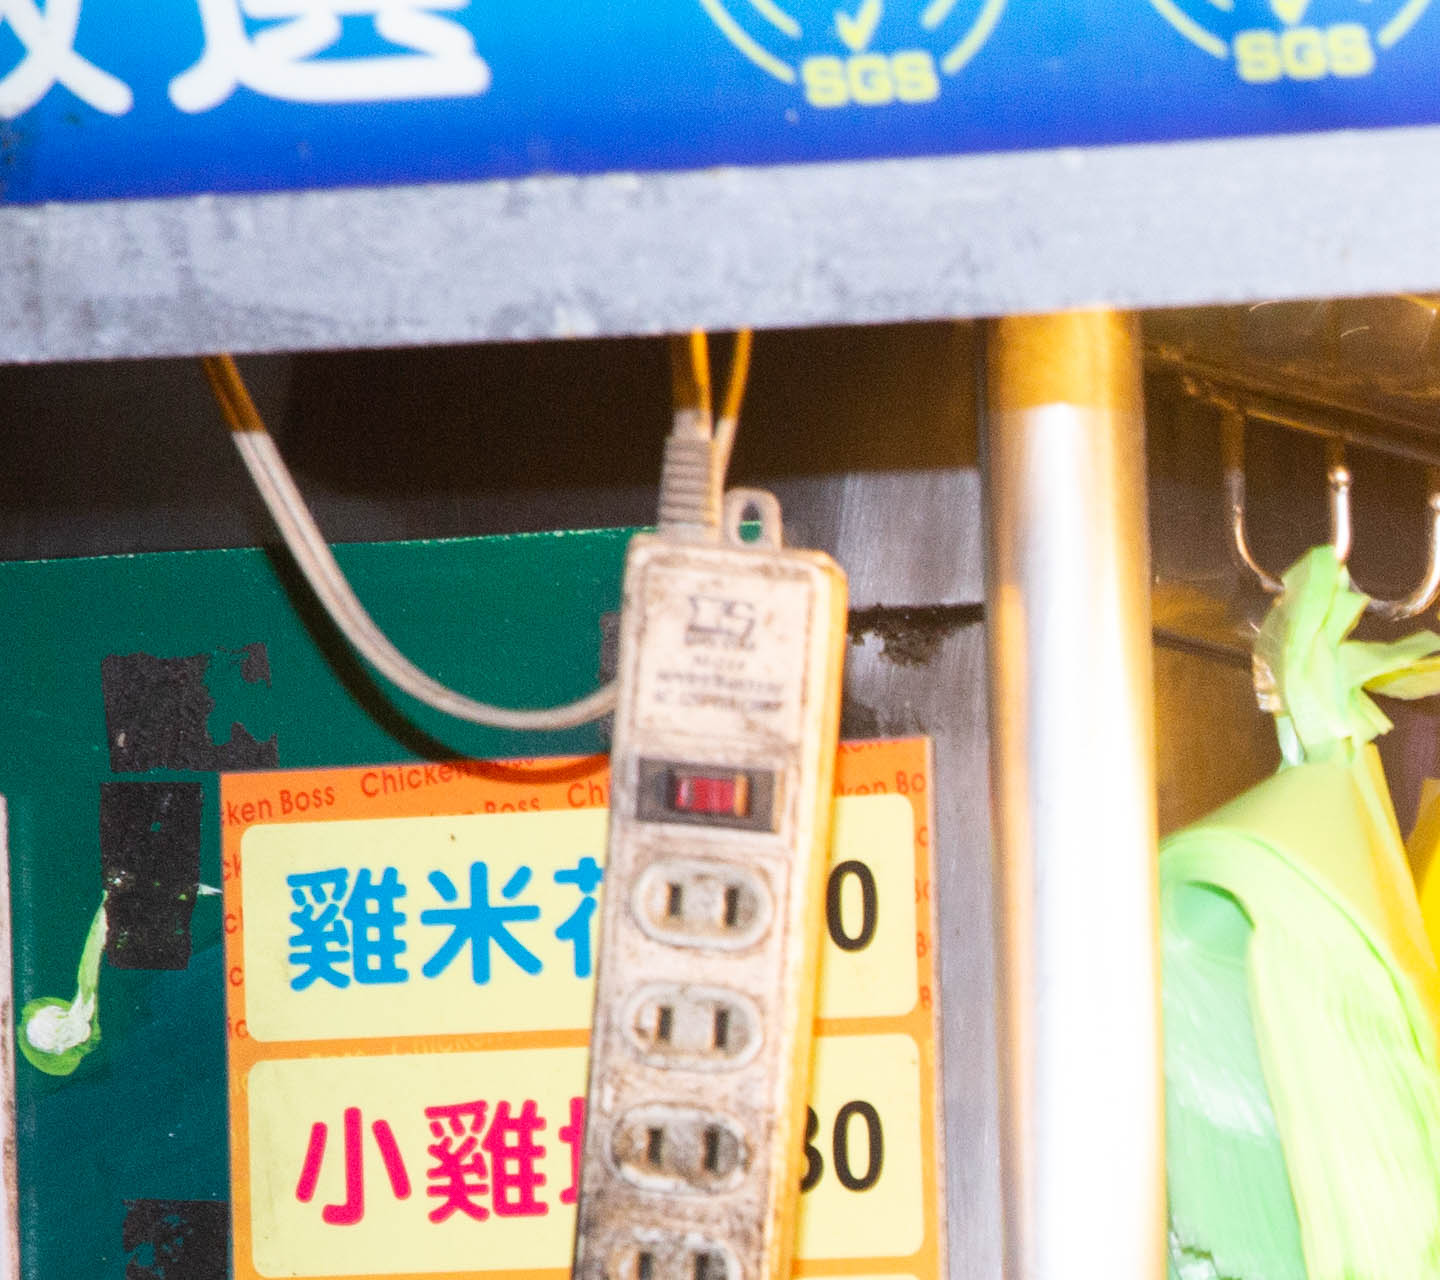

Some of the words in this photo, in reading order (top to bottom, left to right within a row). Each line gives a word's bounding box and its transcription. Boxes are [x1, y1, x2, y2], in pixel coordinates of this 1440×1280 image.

[801, 50, 940, 109] SGS
[1234, 23, 1375, 83] SGS
[223, 796, 274, 826] ken
[280, 783, 336, 816] Boss
